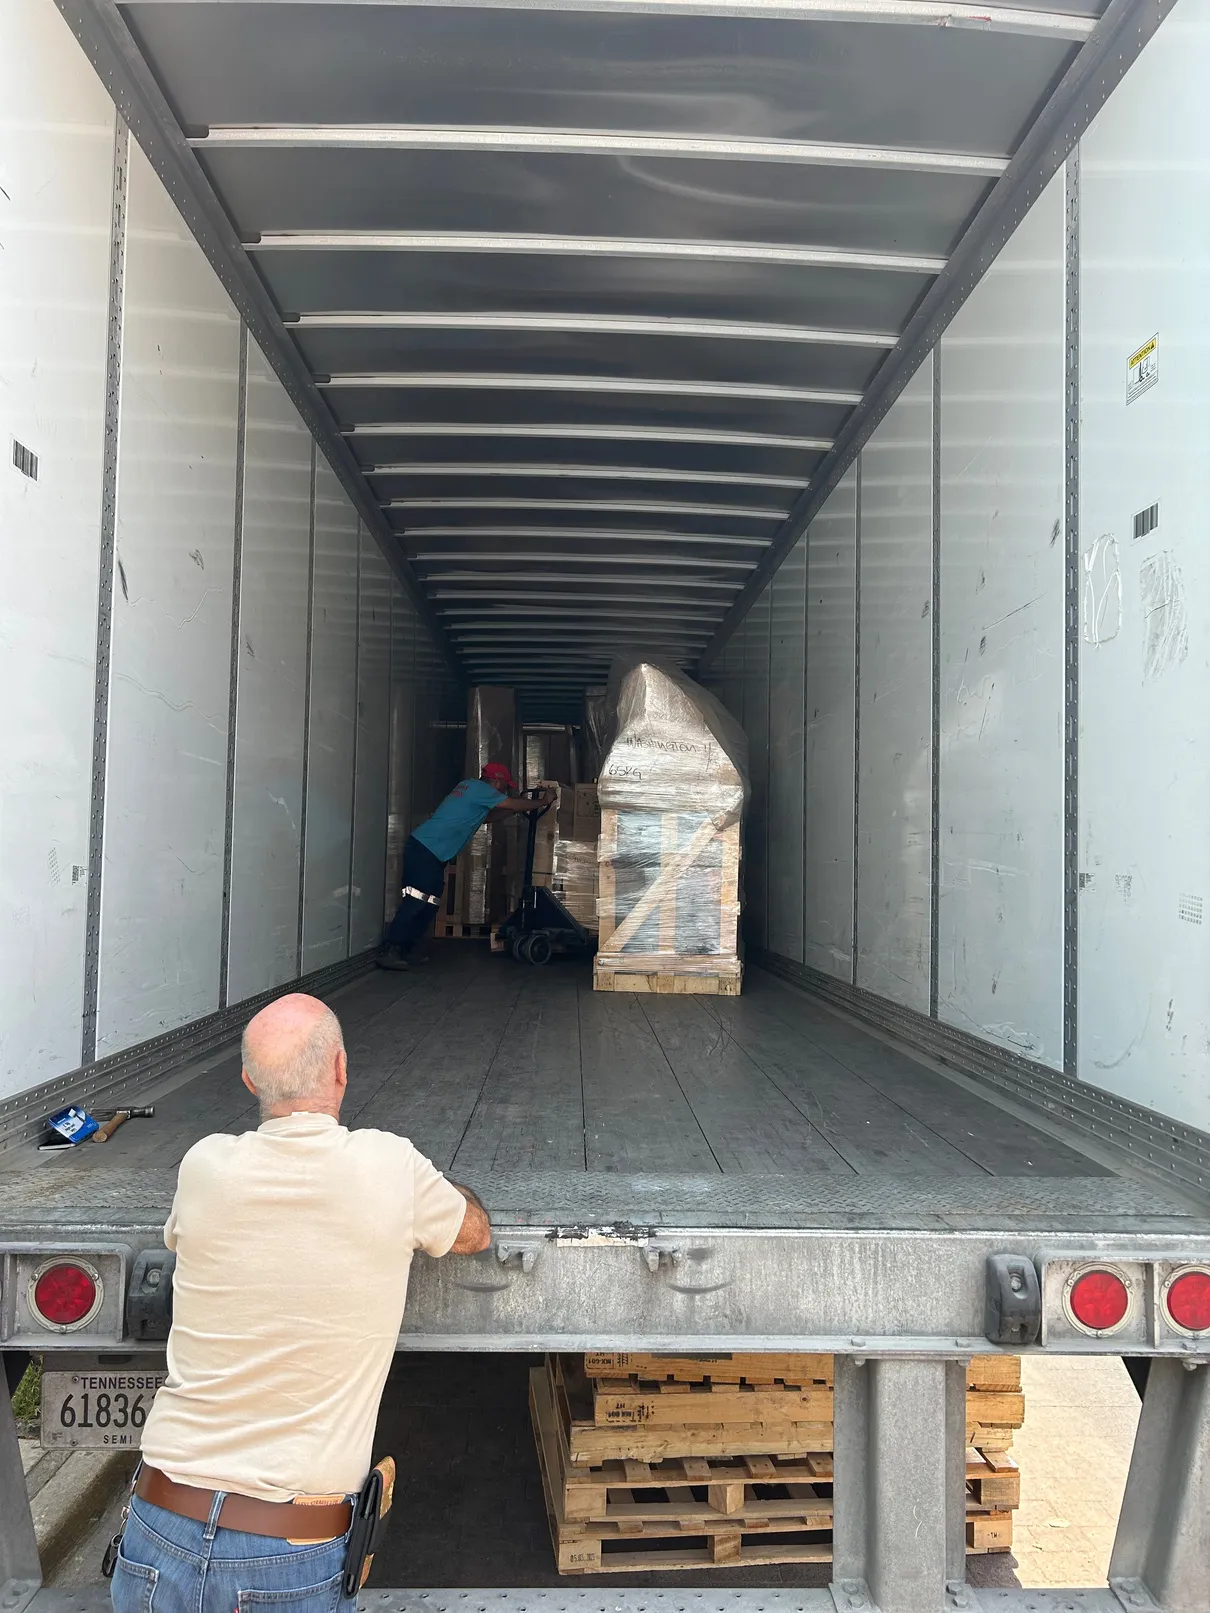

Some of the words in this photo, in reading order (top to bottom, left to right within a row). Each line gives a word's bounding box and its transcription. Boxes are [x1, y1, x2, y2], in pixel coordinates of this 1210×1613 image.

[81, 1377, 163, 1390] TENNESSEE
[60, 1393, 156, 1428] 61836
[103, 1434, 133, 1445] SEMI
